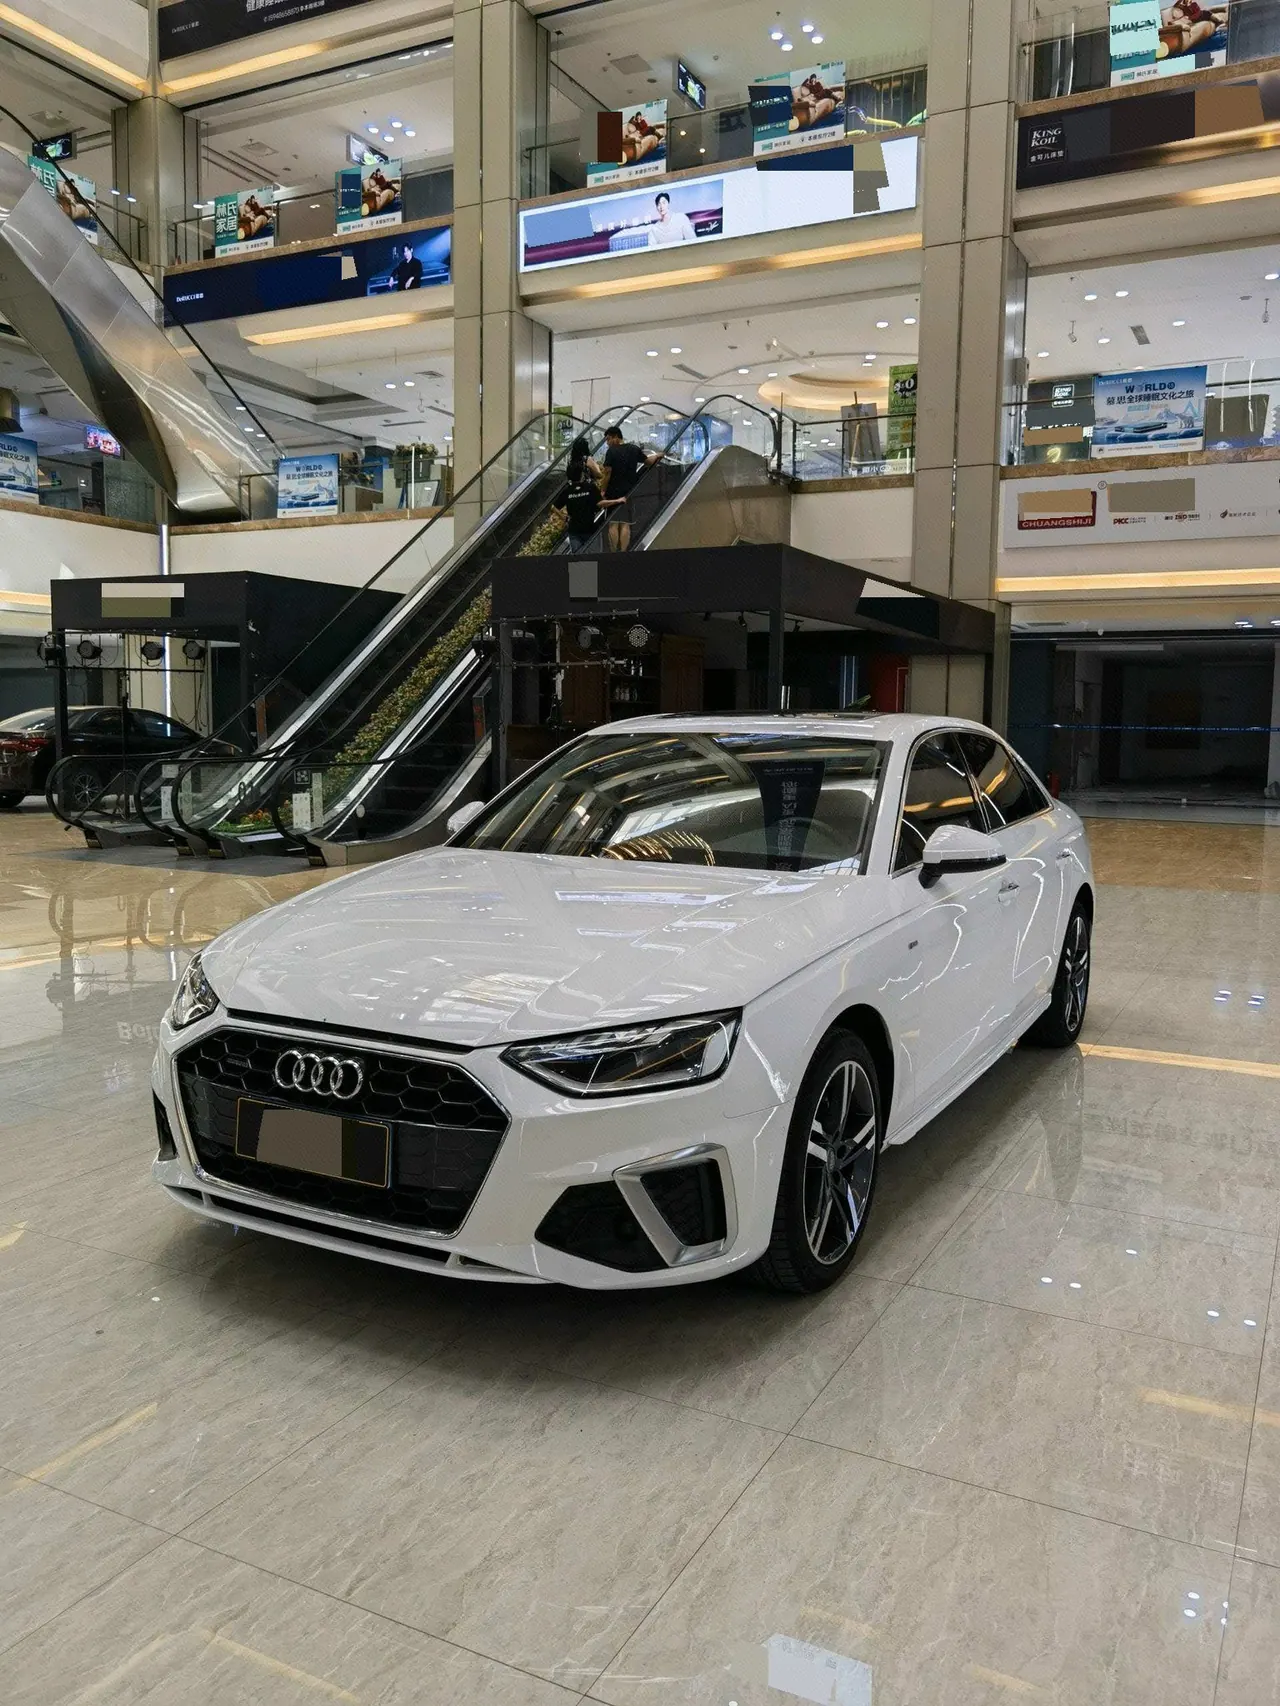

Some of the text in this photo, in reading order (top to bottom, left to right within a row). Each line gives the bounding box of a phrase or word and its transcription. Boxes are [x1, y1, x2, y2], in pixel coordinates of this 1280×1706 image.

[1033, 127, 1062, 139] KING
[1031, 136, 1058, 147] KOIL
[216, 216, 237, 234] 家居
[568, 491, 590, 499] Dickies
[1022, 518, 1092, 528] CHUANGSHIJI
